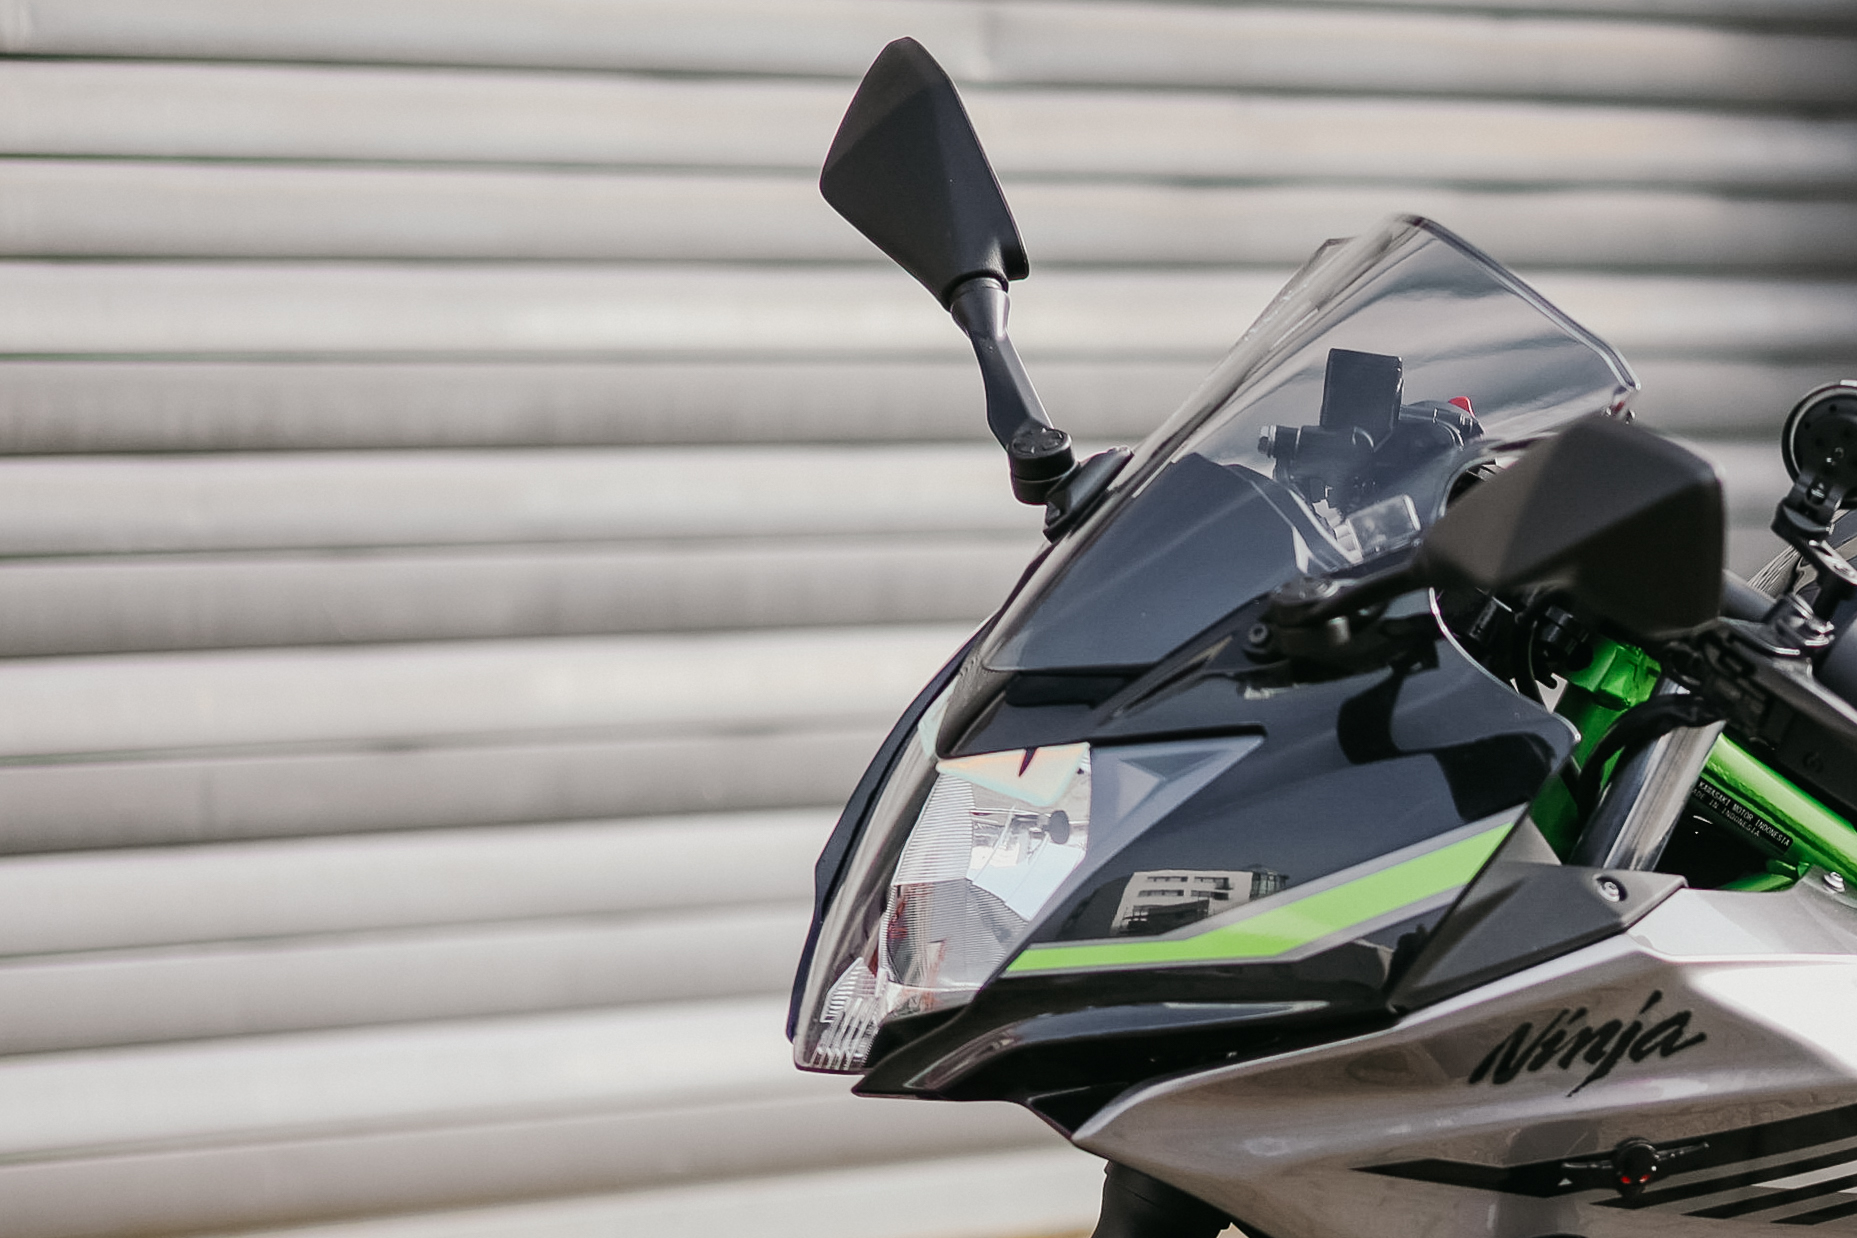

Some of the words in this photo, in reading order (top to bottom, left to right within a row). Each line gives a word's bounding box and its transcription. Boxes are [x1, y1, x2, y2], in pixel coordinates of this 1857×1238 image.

[1698, 781, 1731, 807] KAWASAKI
[1732, 803, 1754, 821] MOTOR
[1755, 819, 1791, 847] INDONESIA
[1708, 799, 1720, 809] IN
[1721, 807, 1760, 837] INDONESIA
[1468, 989, 1707, 1097] Ninja
